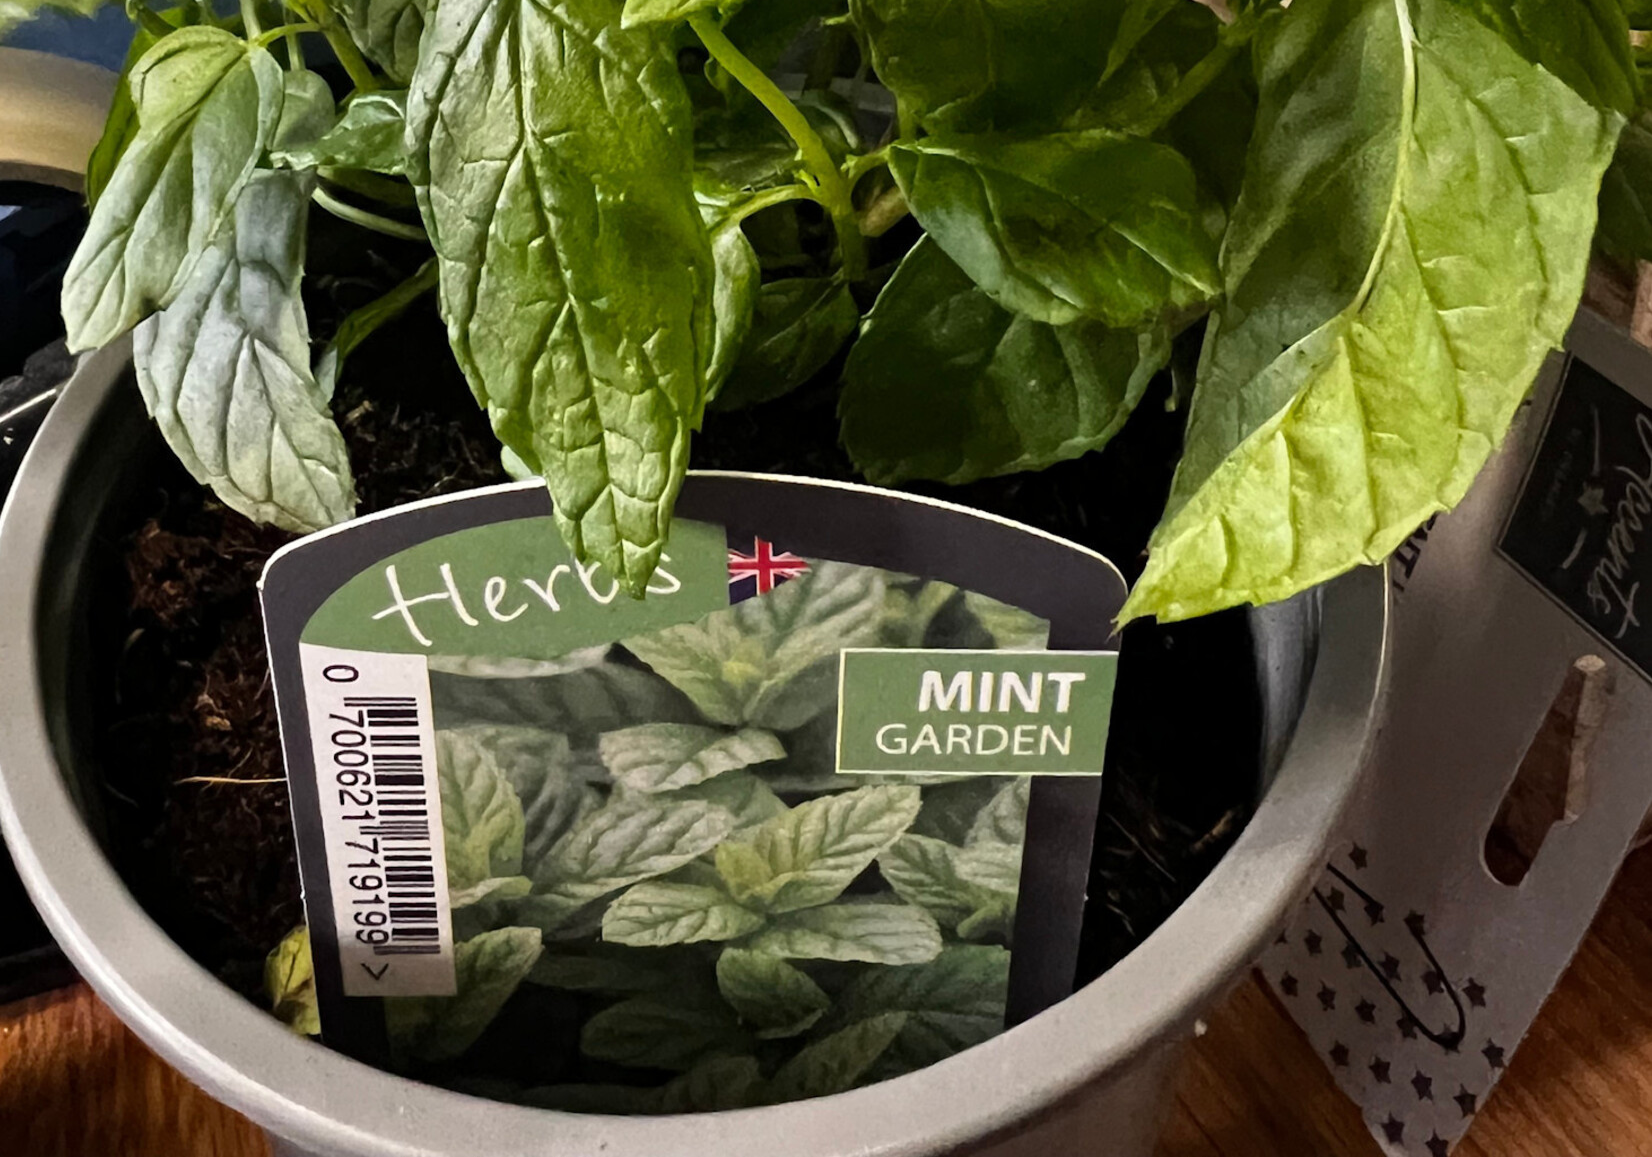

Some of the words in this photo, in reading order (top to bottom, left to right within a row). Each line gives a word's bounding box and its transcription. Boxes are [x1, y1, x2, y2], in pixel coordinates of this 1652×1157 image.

[918, 670, 1087, 713] MINT
[328, 709, 376, 821] 700621
[875, 723, 1072, 756] GARDEN
[344, 837, 390, 945] 719199
